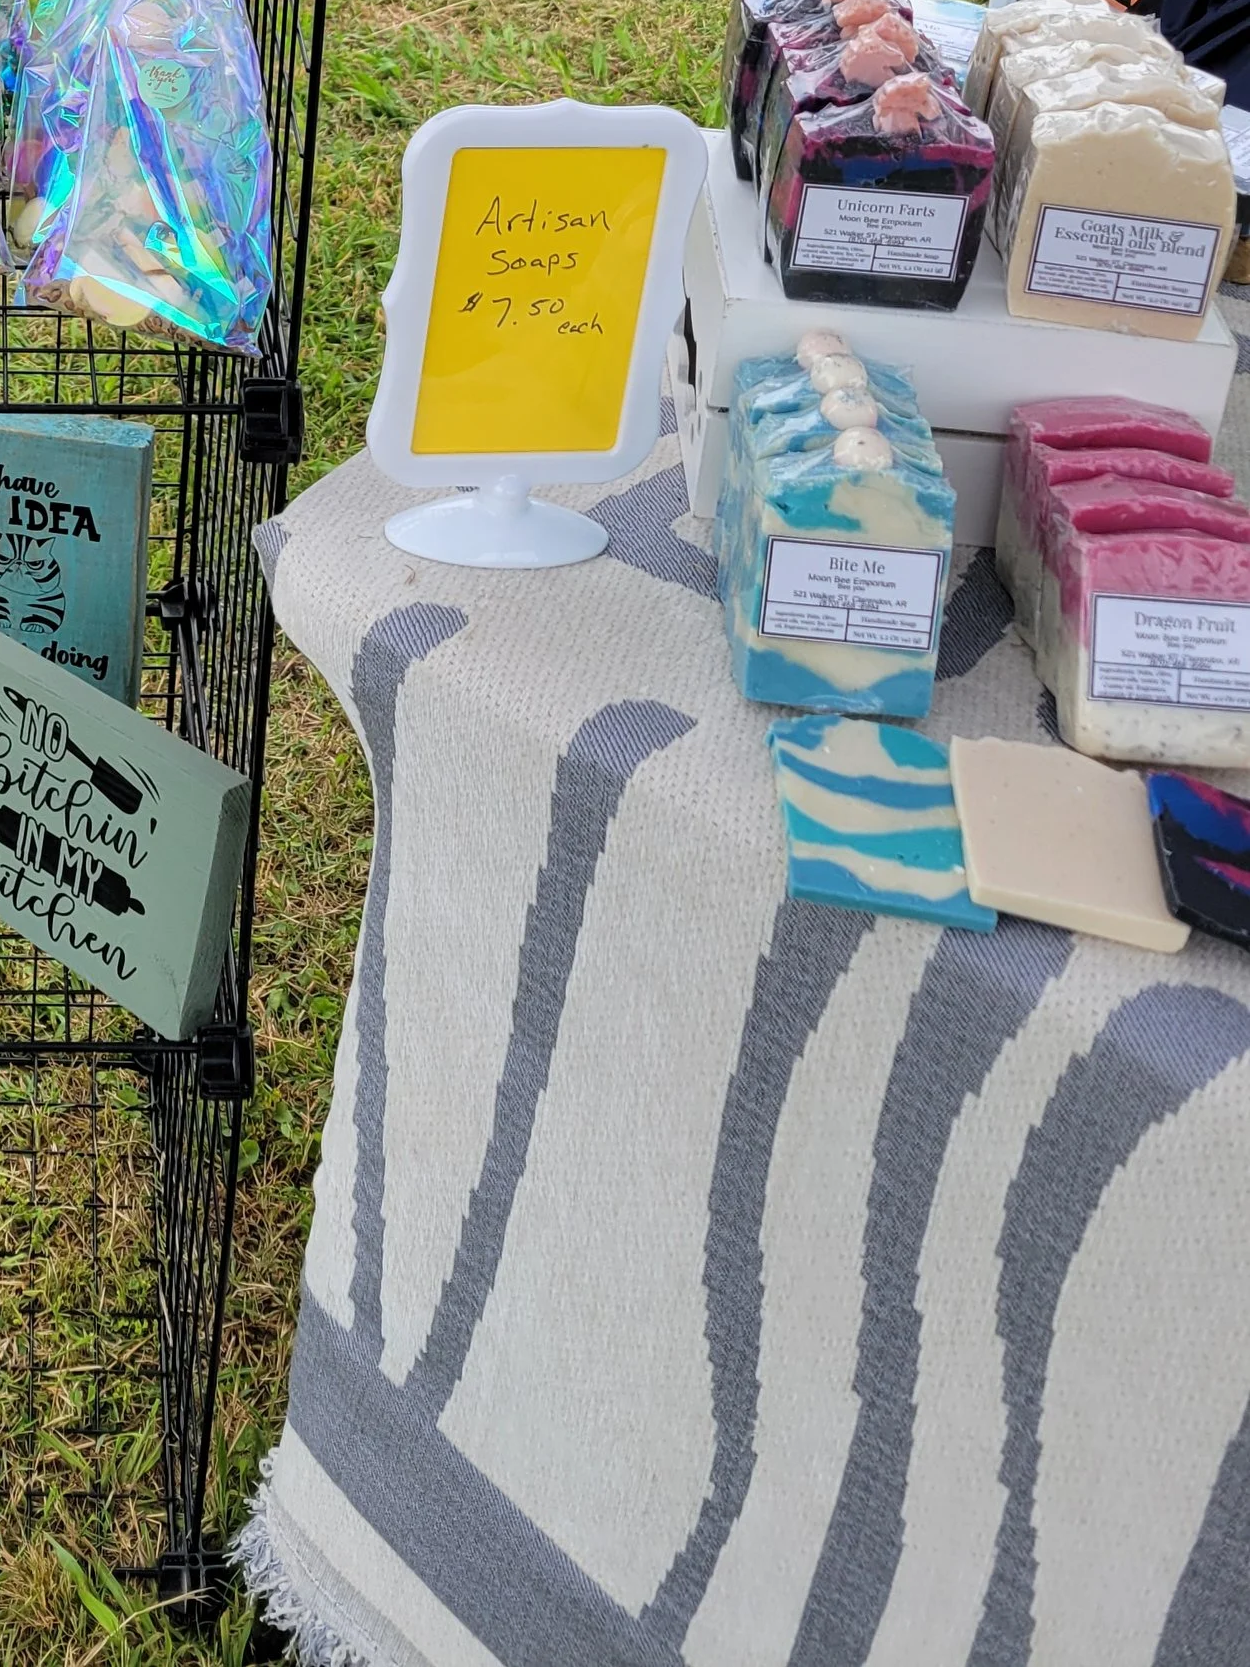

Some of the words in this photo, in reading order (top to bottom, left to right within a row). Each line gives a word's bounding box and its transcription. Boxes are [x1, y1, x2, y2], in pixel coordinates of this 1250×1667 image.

[475, 195, 611, 235] Artisan
[837, 198, 894, 214] Unicorn
[899, 203, 936, 217] Farts
[838, 214, 861, 223] Moon
[863, 216, 879, 224] Bee
[881, 217, 922, 227] Emporium
[1081, 218, 1124, 236] Goats
[1130, 225, 1165, 241] Milk
[1054, 226, 1124, 247] Essential
[1128, 234, 1156, 251] oils
[1161, 240, 1206, 258] Blend
[557, 312, 604, 335] each
[8, 495, 101, 543] IDEA
[829, 556, 858, 572] Bite
[863, 560, 886, 574] Me
[808, 573, 832, 583] Moon
[834, 575, 850, 584] Bee
[853, 577, 896, 588] Emporium
[1134, 611, 1192, 631] Dragon
[1196, 616, 1237, 633] Fruit
[40, 640, 109, 681] doing
[19, 697, 70, 763] NO
[15, 812, 46, 872] IN
[54, 837, 104, 907] MY
